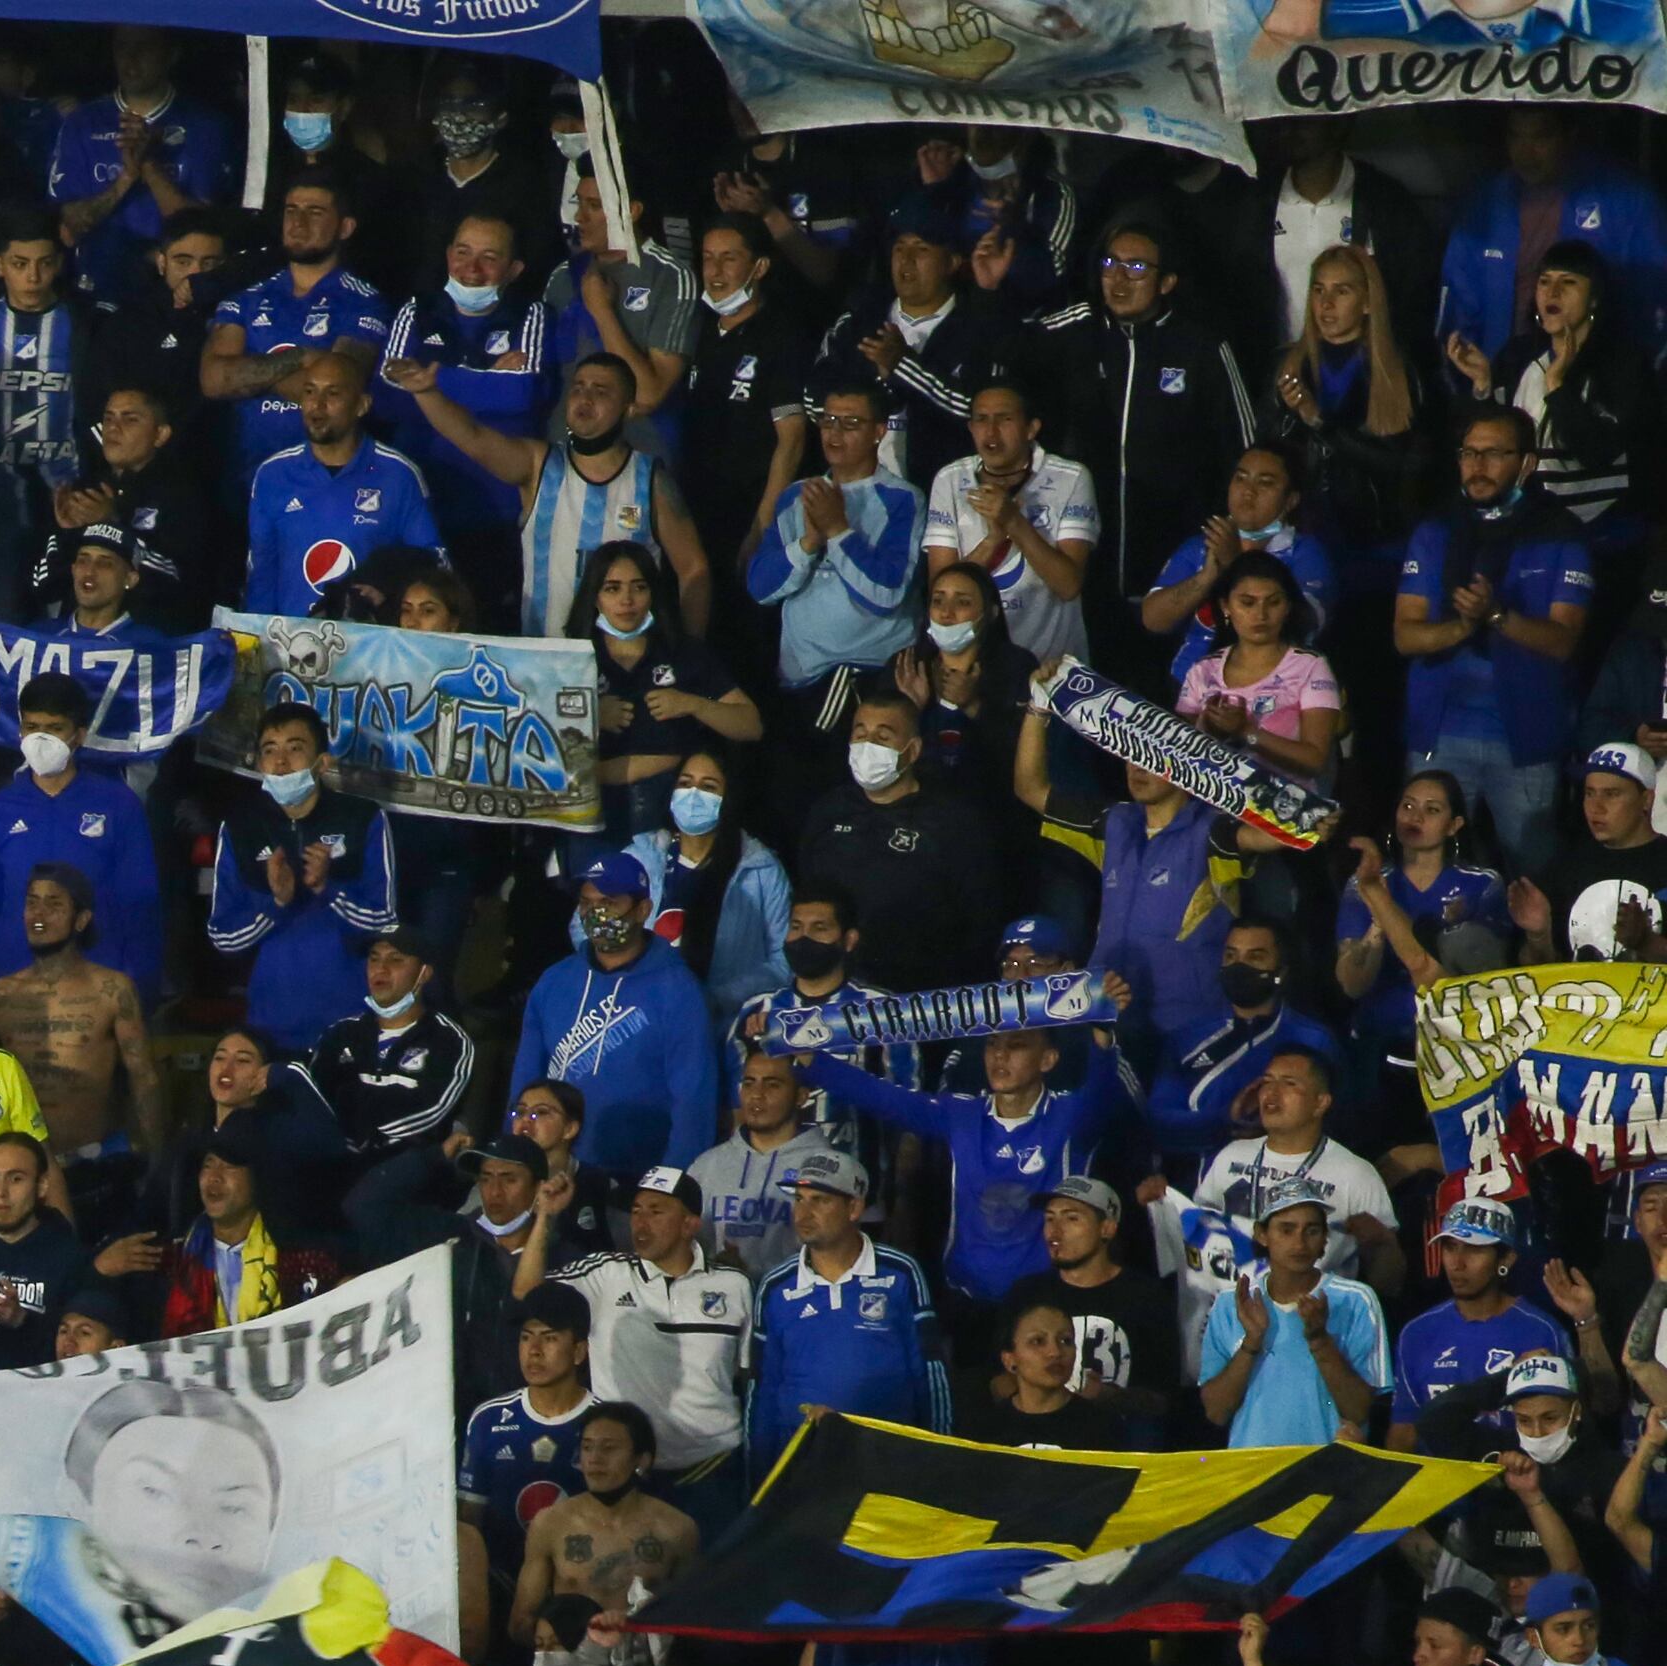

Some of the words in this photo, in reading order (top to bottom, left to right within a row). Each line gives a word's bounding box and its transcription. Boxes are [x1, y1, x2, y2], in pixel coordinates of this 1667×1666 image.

[1277, 40, 1645, 112] Querido
[728, 379, 756, 401] 75
[840, 979, 1034, 1044] GIRARDOT
[710, 1196, 792, 1231] LEONA
